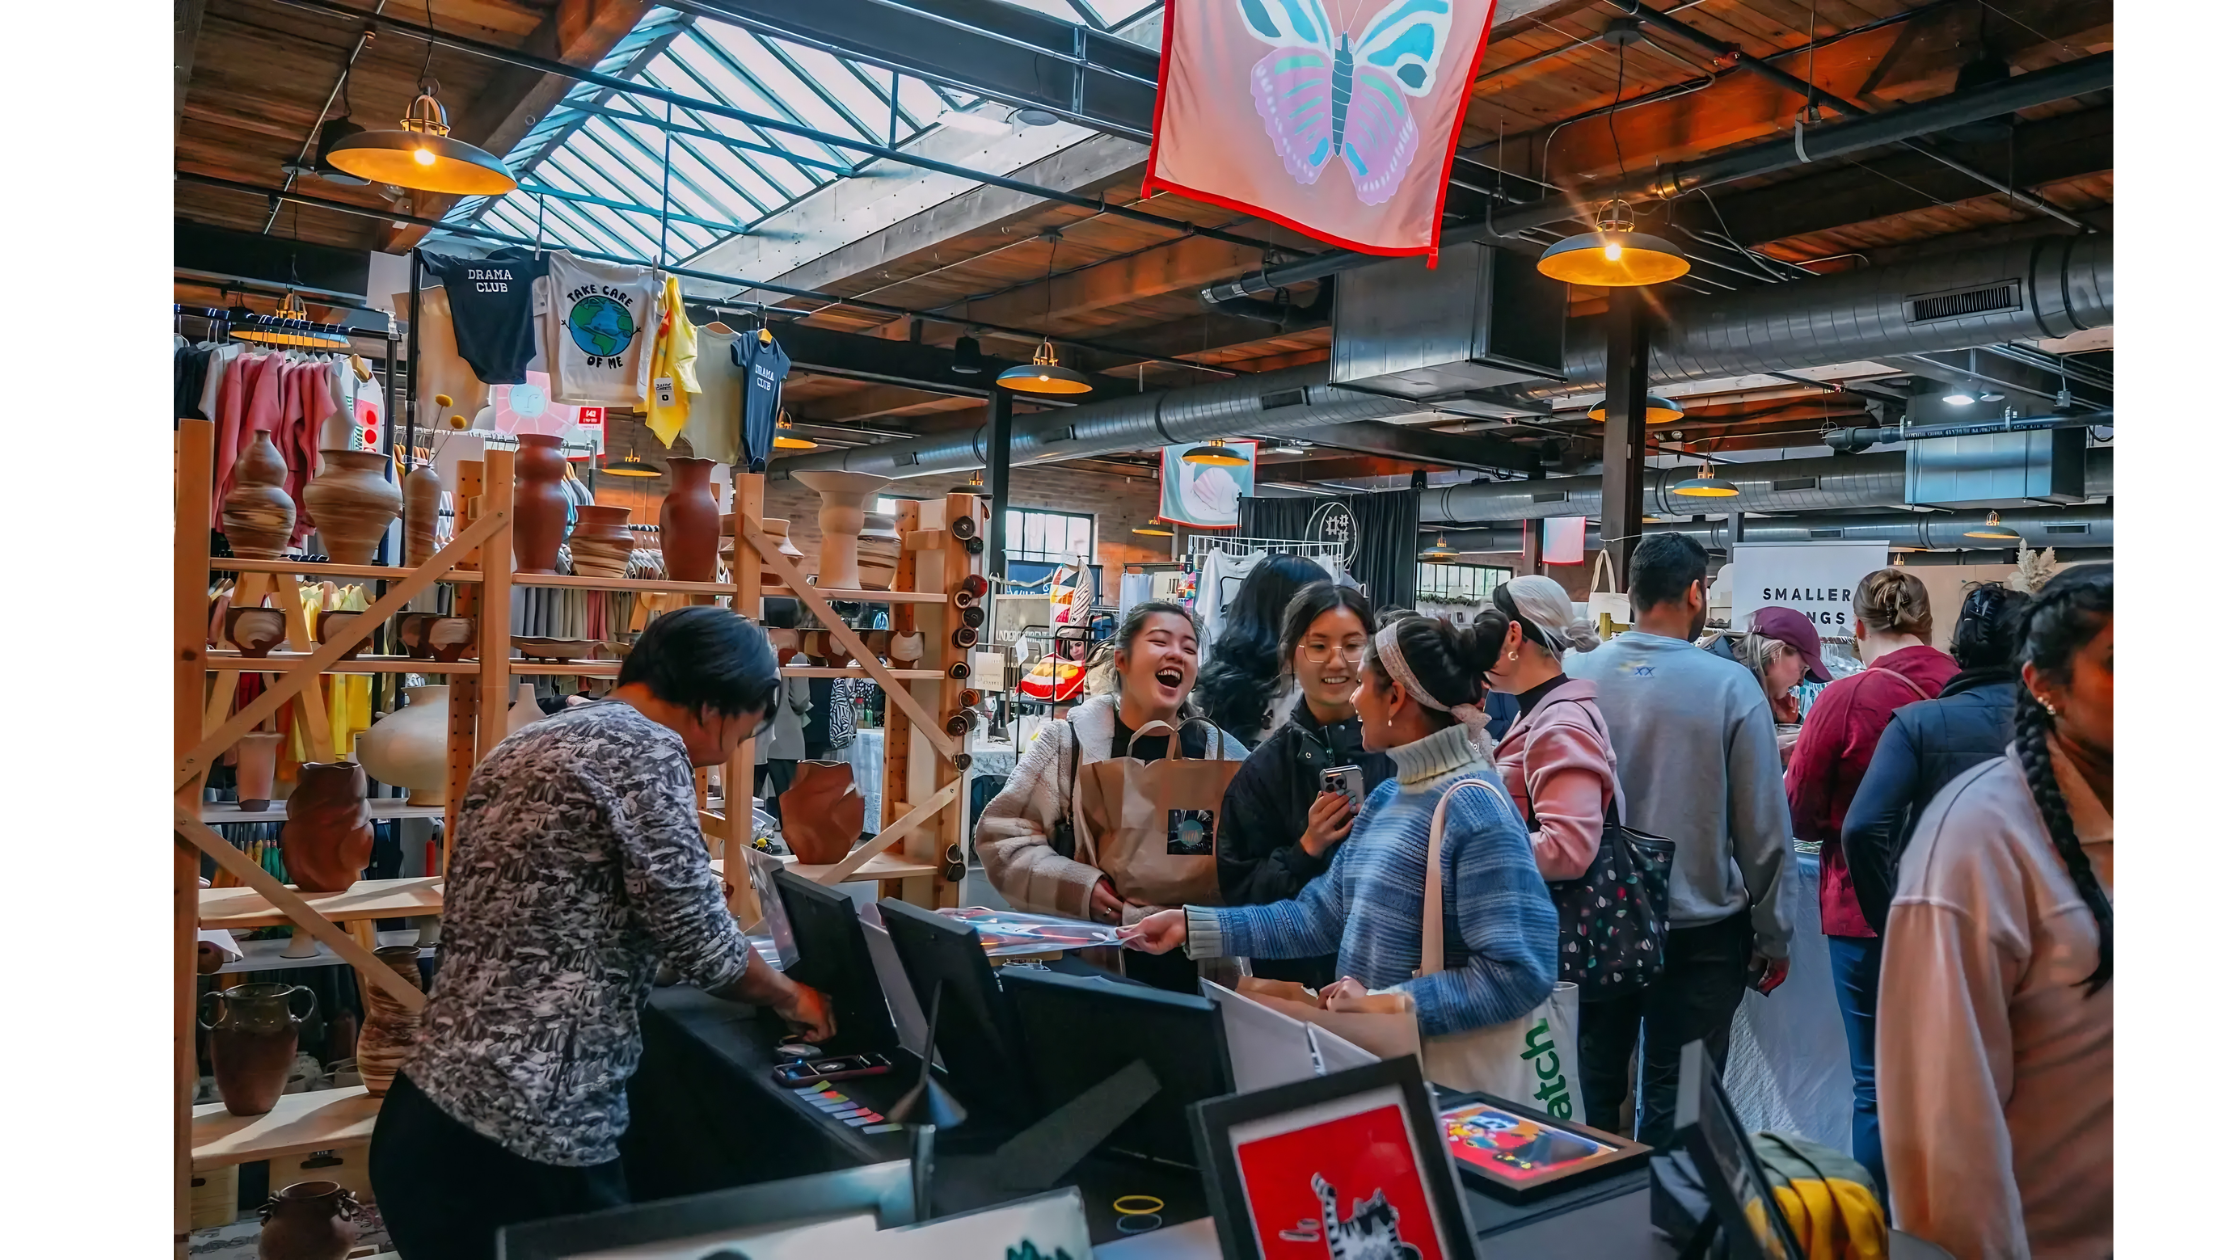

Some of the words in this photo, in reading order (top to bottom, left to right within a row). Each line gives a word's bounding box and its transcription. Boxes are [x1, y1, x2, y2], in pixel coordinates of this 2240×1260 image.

[468, 269, 513, 280] DRAMA
[476, 282, 508, 292] CLUB
[567, 284, 597, 302] TAKE
[602, 285, 633, 307] CARE
[587, 356, 603, 368] OF
[607, 356, 623, 369] ME
[755, 363, 774, 381] DRAMA
[757, 377, 771, 391] CLUB
[1763, 588, 1851, 601] SMALLER
[1806, 611, 1845, 624] NGS
[996, 630, 1049, 643] UNDERCRRENT
[1520, 1017, 1573, 1121] atch
